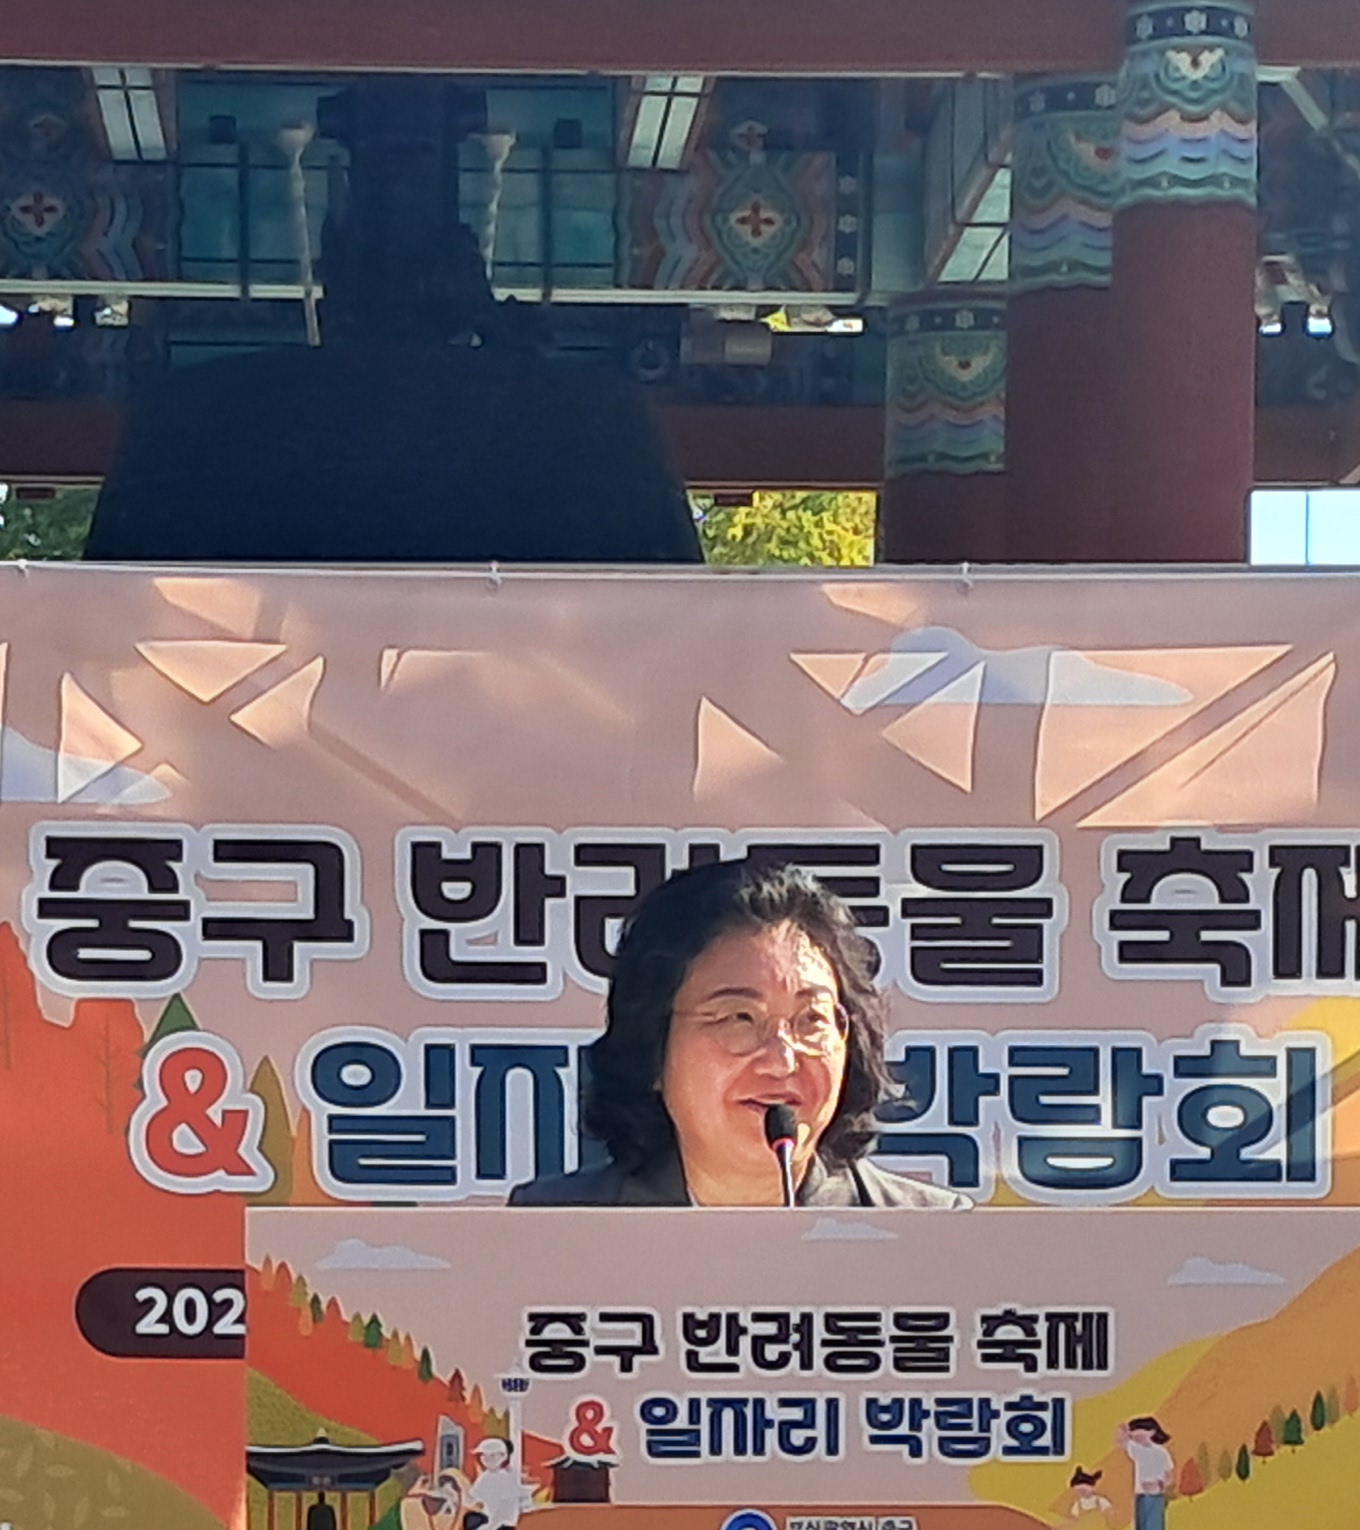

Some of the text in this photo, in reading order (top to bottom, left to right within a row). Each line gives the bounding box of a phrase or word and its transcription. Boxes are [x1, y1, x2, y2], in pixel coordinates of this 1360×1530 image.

[37, 836, 354, 982] 중구
[146, 1040, 1316, 1190] & 일자 박람회
[524, 1309, 1109, 1374] 중구 반려동물 축제
[568, 1394, 1067, 1459] & 일자리 박람회
